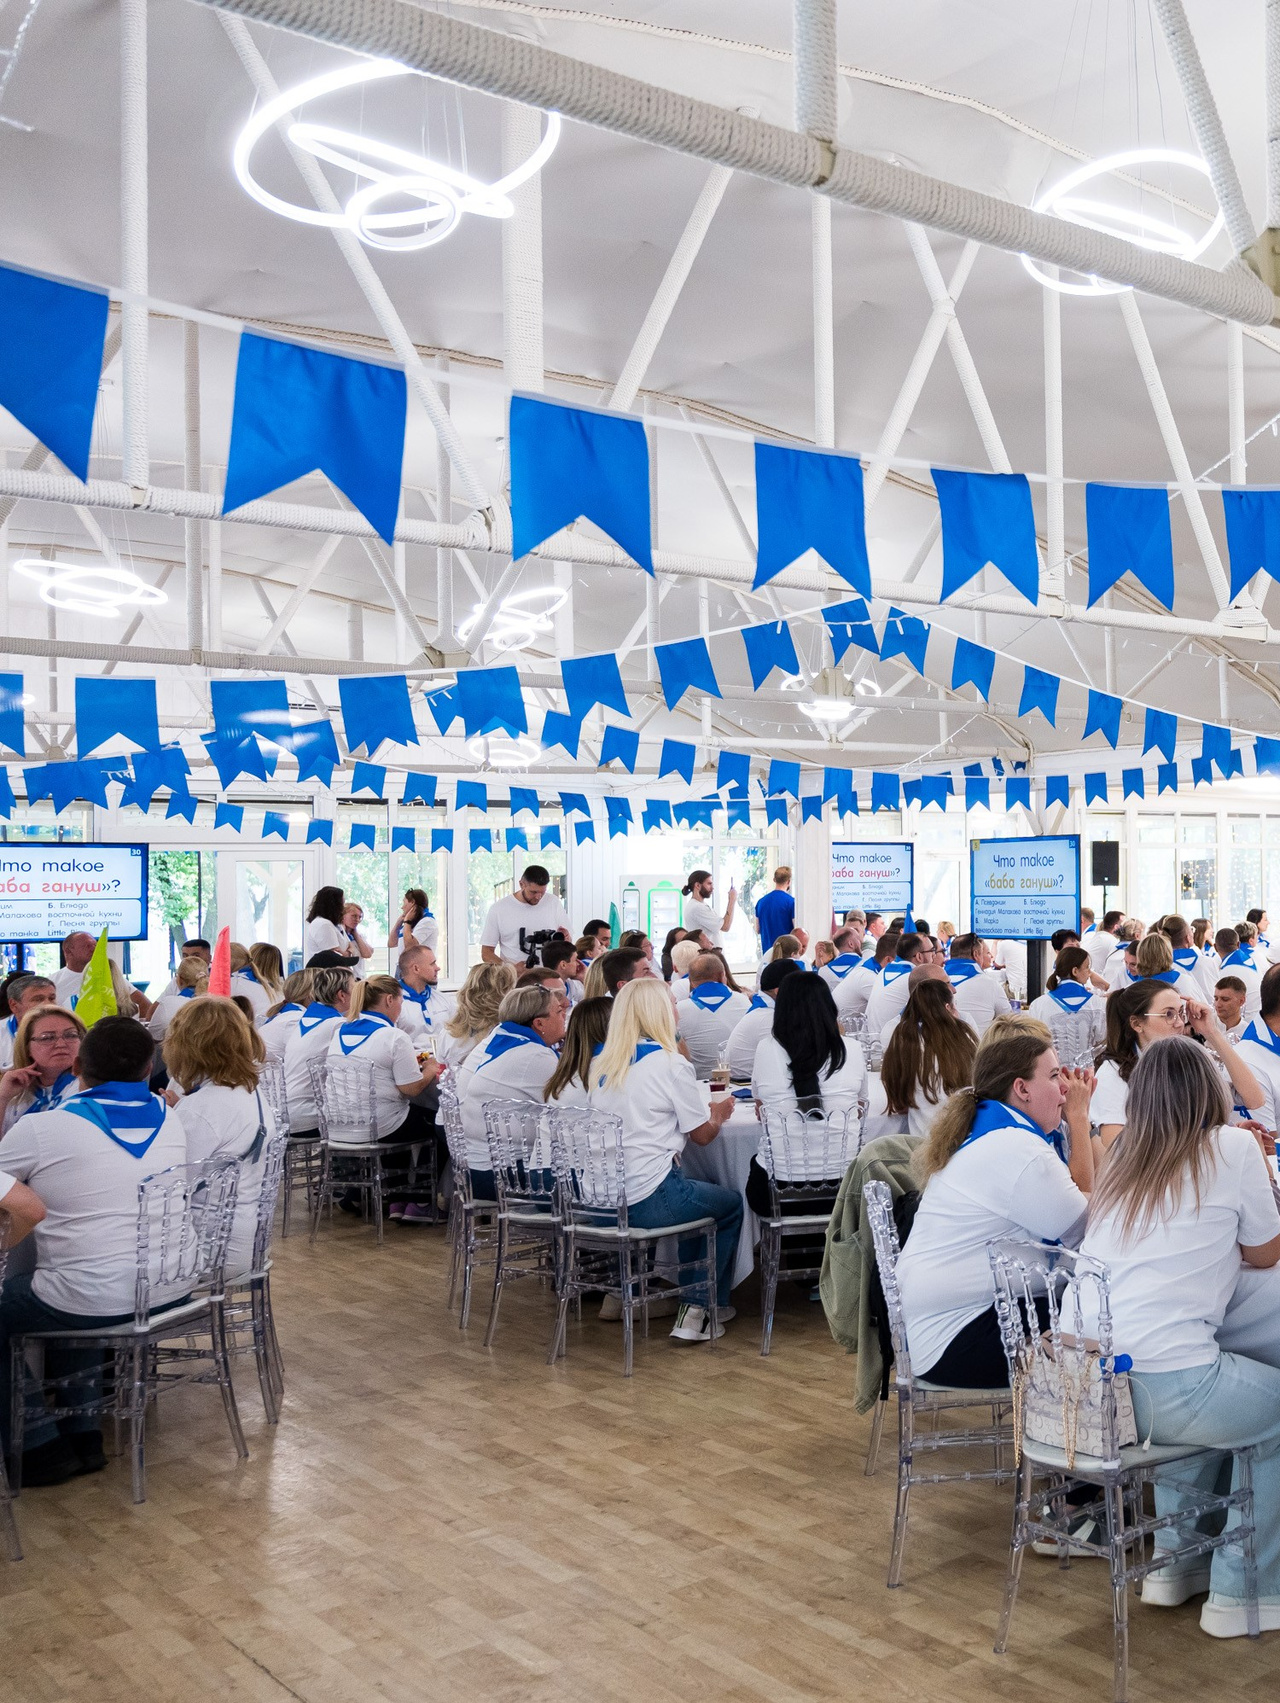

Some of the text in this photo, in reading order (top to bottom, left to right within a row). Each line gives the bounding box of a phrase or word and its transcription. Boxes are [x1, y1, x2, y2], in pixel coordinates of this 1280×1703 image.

[131, 848, 142, 856] 30
[859, 853, 892, 863] такое
[0, 858, 105, 872] то такое
[993, 852, 1055, 868] Что такое
[42, 879, 121, 896] гануш»?
[984, 872, 1065, 892] «баба гануш»?
[60, 902, 89, 911] Блюдо
[48, 910, 123, 919] восточной кухни
